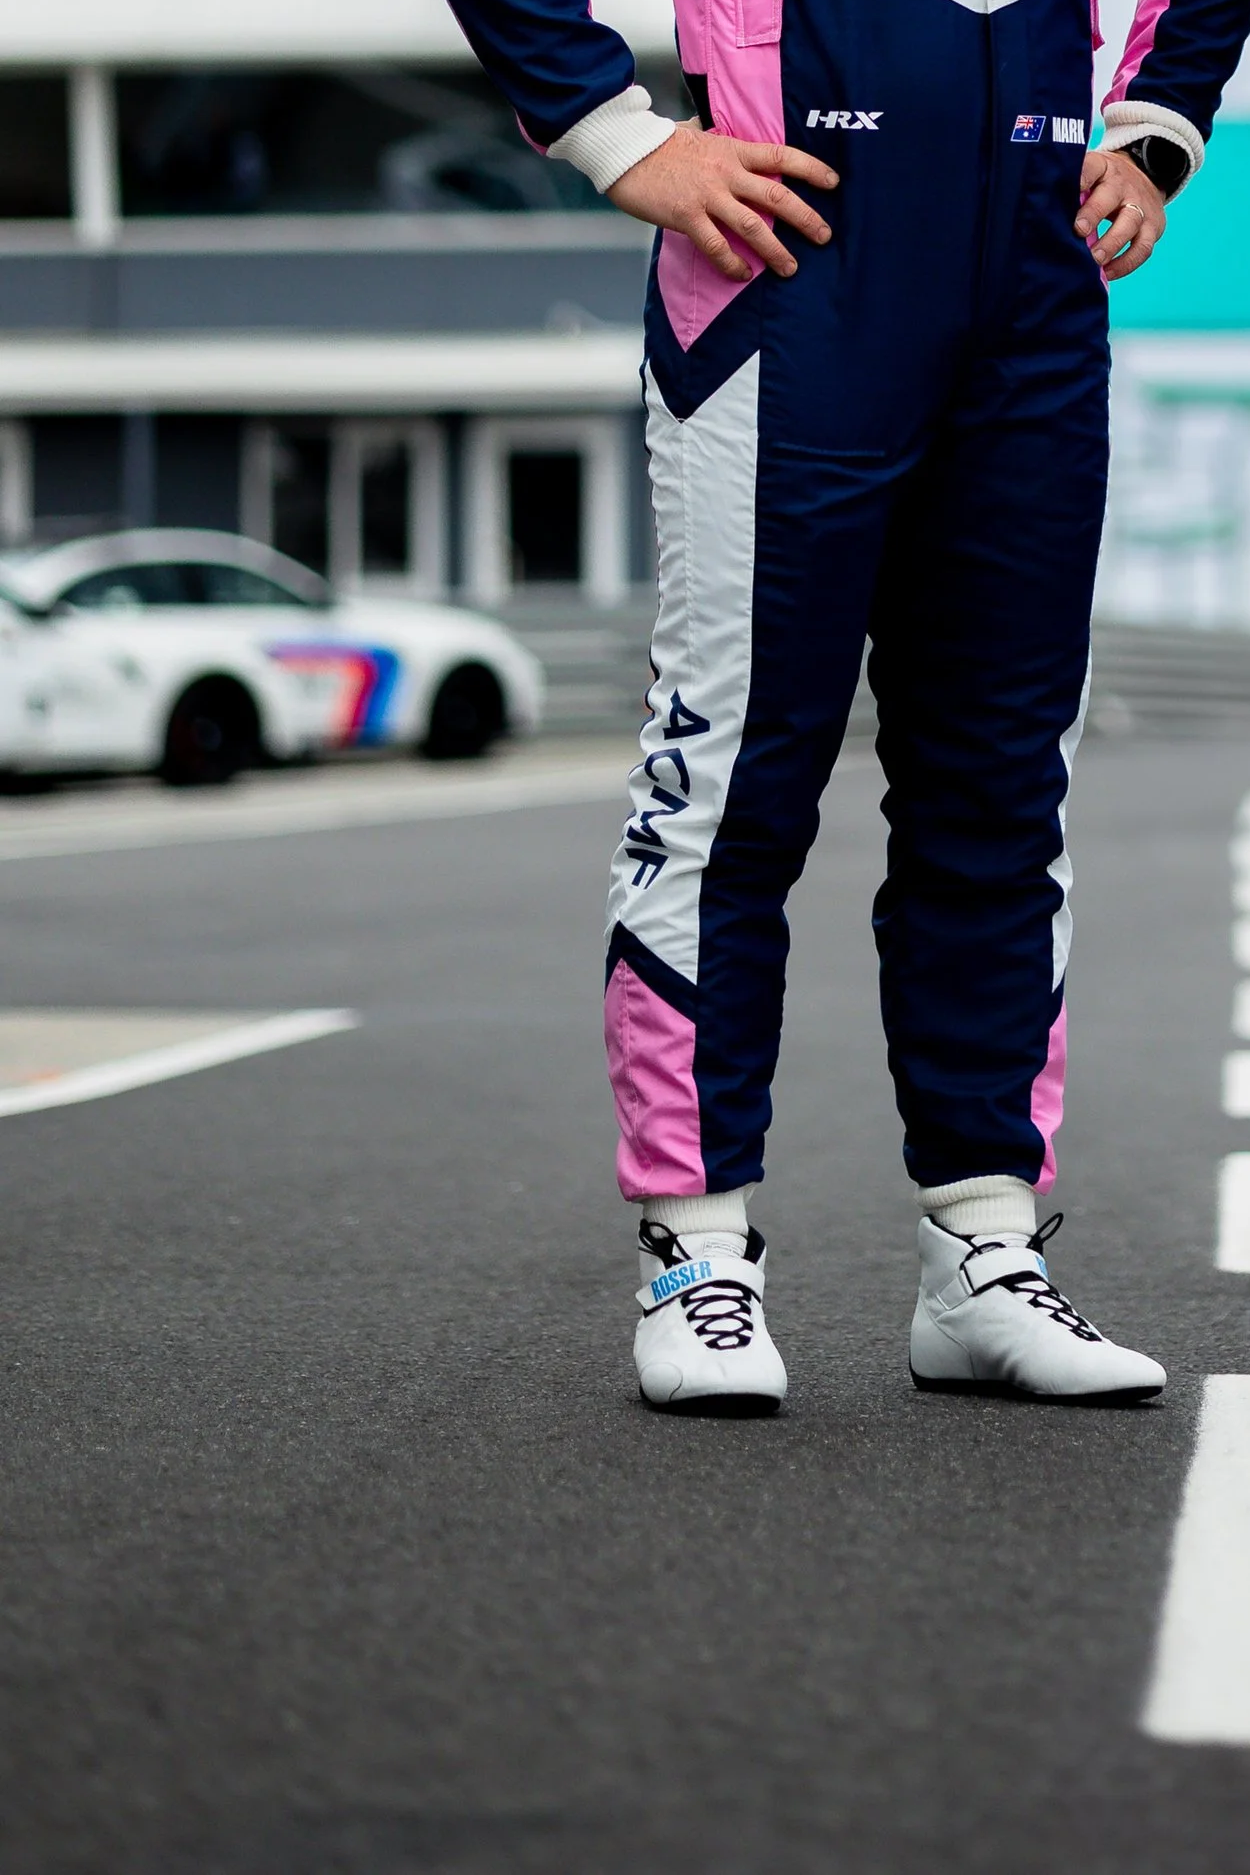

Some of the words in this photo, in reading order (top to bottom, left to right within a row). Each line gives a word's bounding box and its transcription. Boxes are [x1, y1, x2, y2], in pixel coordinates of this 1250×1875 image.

[805, 109, 885, 131] HRX
[1052, 116, 1086, 145] MARK
[624, 686, 711, 891] ACMF
[651, 1260, 712, 1303] ROSSER
